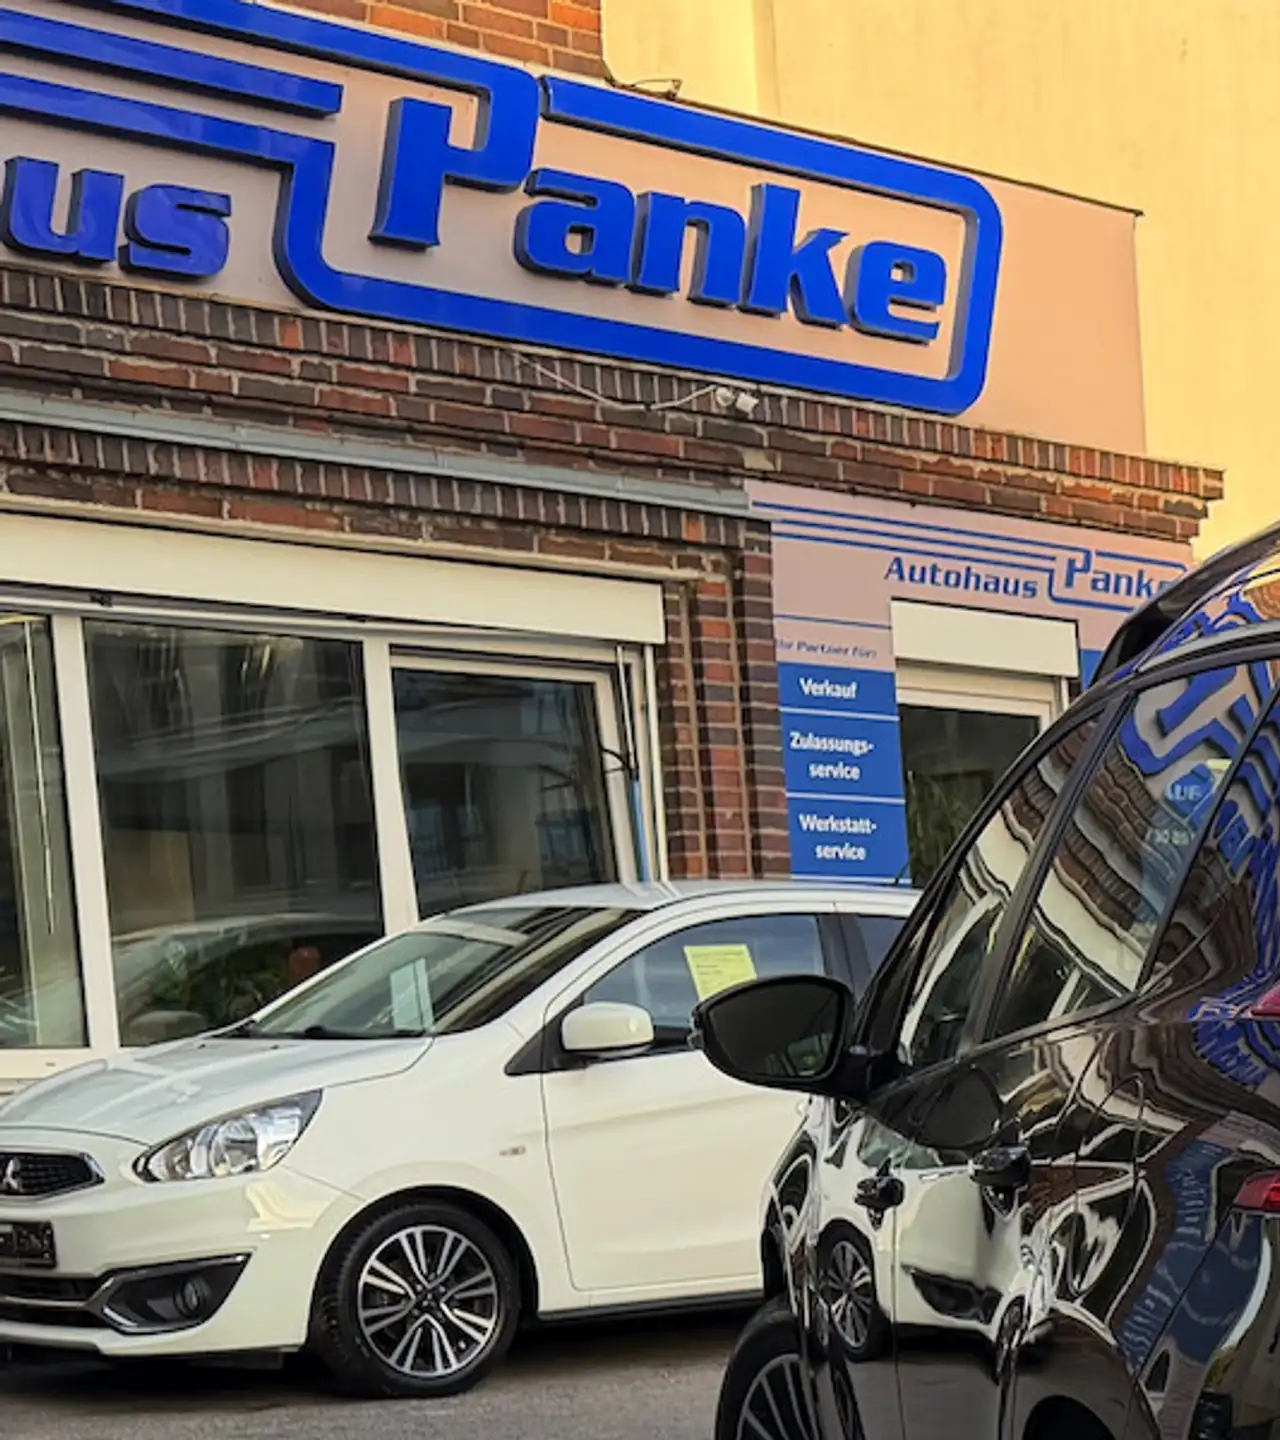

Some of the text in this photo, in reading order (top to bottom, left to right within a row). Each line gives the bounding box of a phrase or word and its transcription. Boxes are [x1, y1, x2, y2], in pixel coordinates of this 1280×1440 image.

[367, 66, 948, 345] Panke
[884, 556, 1038, 599] Autohaus
[799, 676, 857, 699] Verkauf
[789, 731, 875, 756] Zulassungs-
[808, 760, 861, 781] service
[799, 813, 877, 836] Werkstatt-
[815, 842, 867, 861] service
